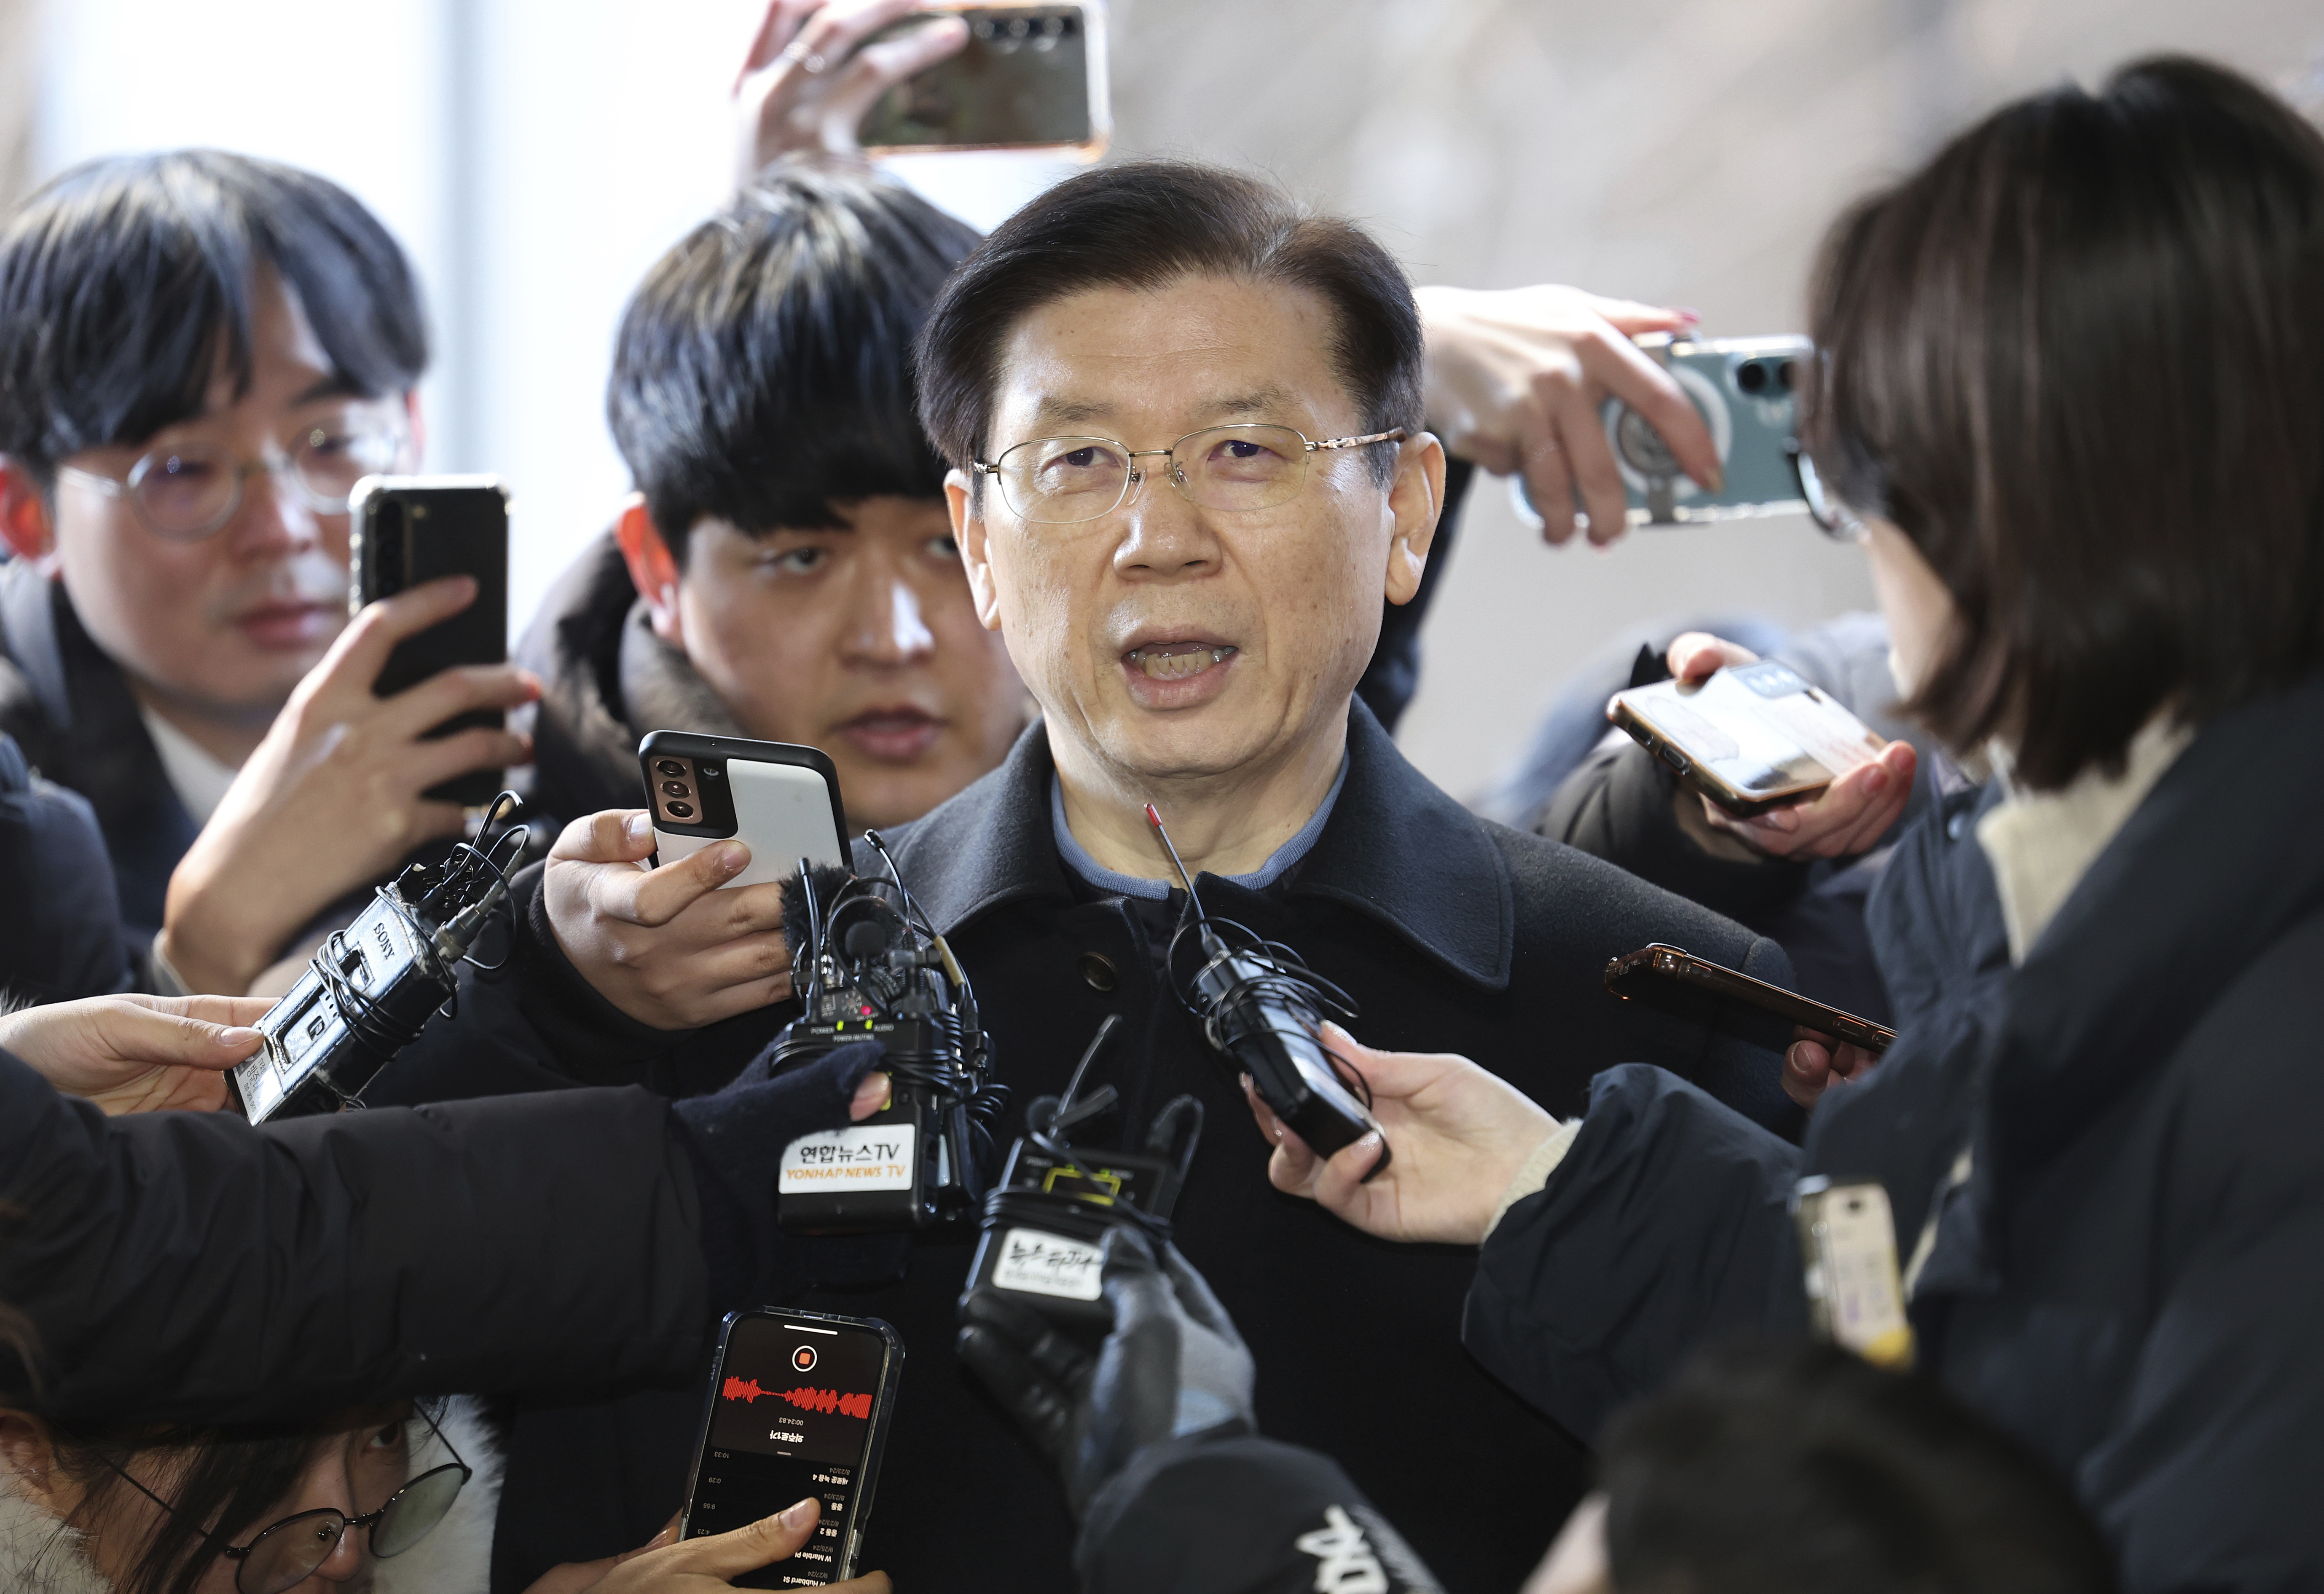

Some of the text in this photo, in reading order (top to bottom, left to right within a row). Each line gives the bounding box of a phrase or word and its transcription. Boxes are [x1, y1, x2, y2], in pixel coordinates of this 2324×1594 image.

[374, 923, 394, 960] SONY
[801, 1144, 900, 1163] 연합뉴스TV
[786, 1164, 906, 1180] YONHAP NEWS TV
[779, 1417, 804, 1426] 00:24.83
[770, 1430, 804, 1443] 의주로1가
[818, 1474, 830, 1483] 녹음
[831, 1476, 848, 1485] 새로운
[824, 1493, 845, 1501] 8/23/24
[802, 1552, 824, 1561] Marble
[791, 1577, 818, 1587] Hubbard
